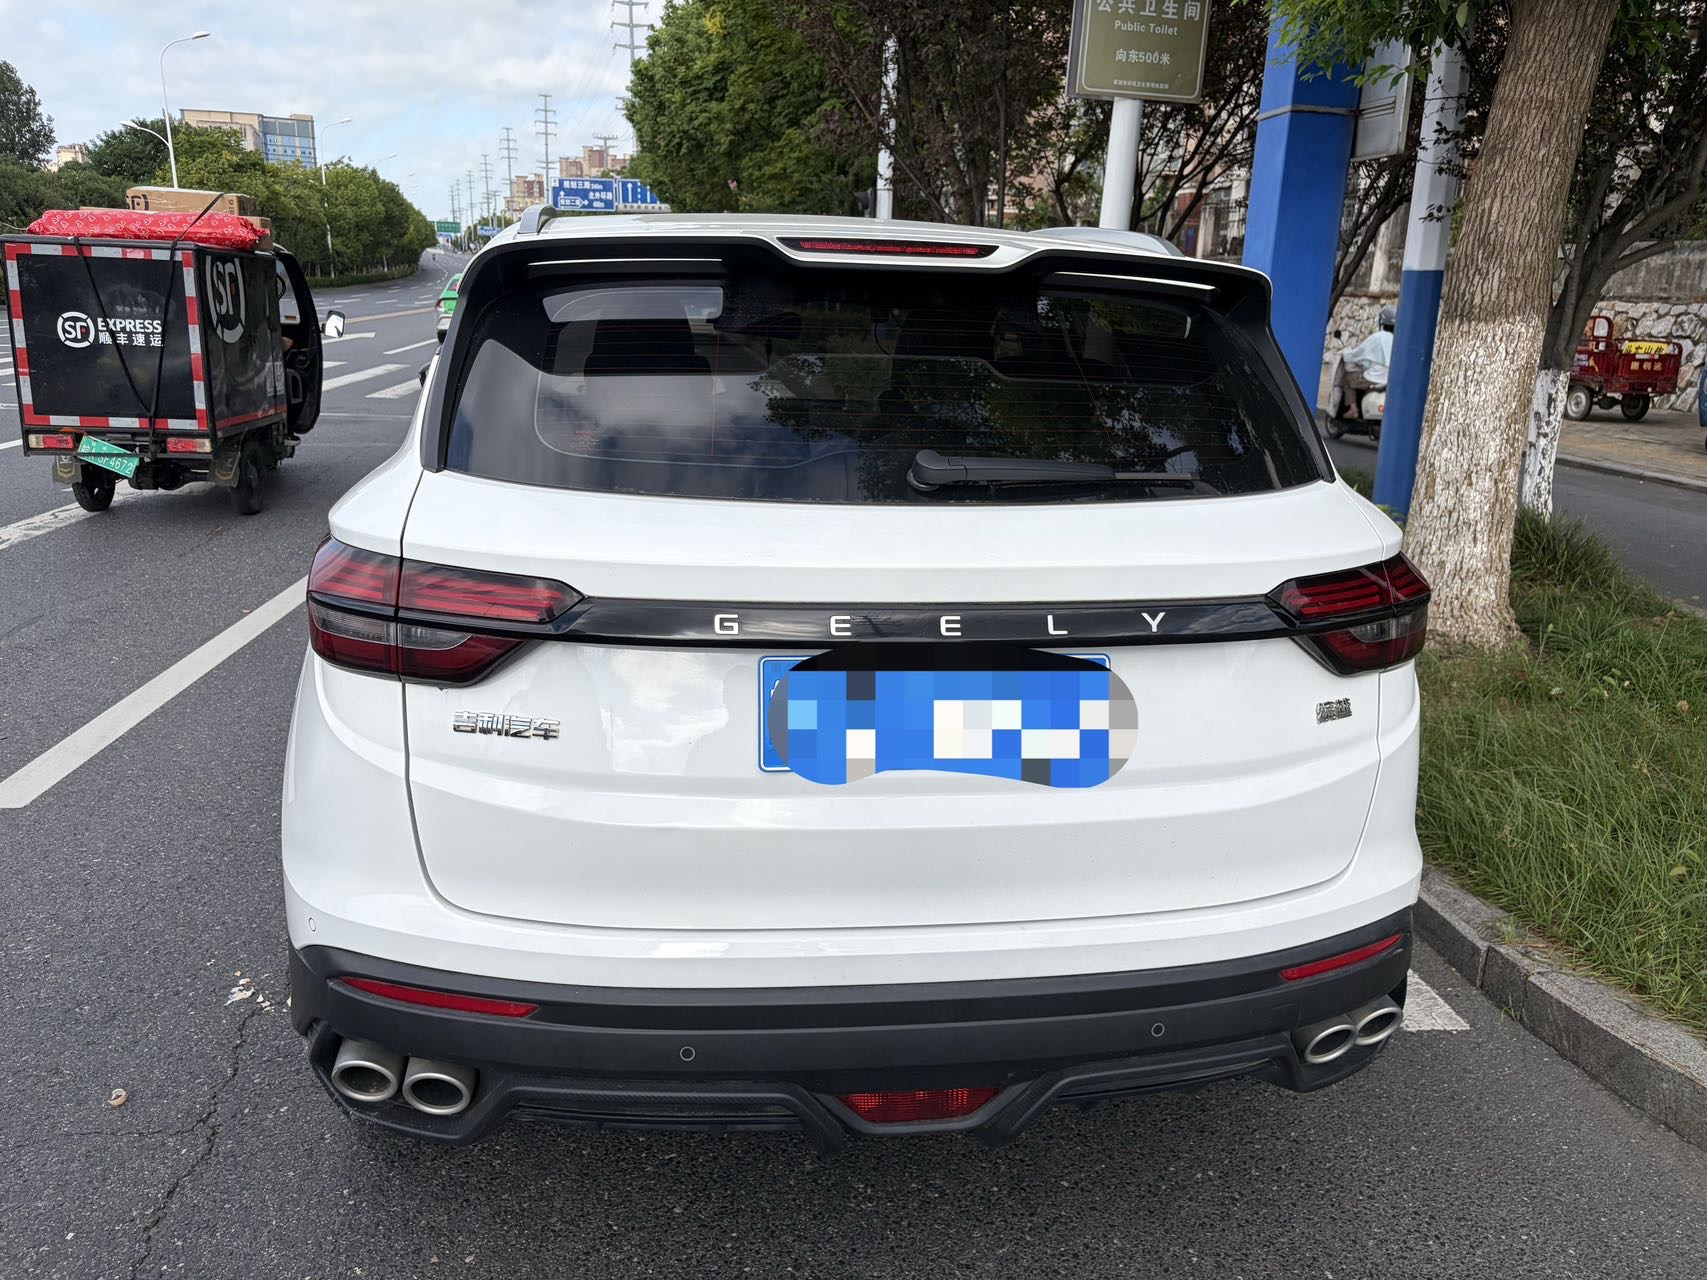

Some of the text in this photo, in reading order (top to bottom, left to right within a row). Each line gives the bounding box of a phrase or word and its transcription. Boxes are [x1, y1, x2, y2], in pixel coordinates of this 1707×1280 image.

[1097, 0, 1201, 21] 公共卫生间
[1114, 20, 1178, 36] Public Toilet
[1115, 48, 1171, 65] 向东500米
[97, 317, 162, 333] EXPRESS
[98, 331, 164, 347] 顺丰速运
[714, 611, 1166, 636] GEELY
[453, 711, 560, 740] 吉利汽车
